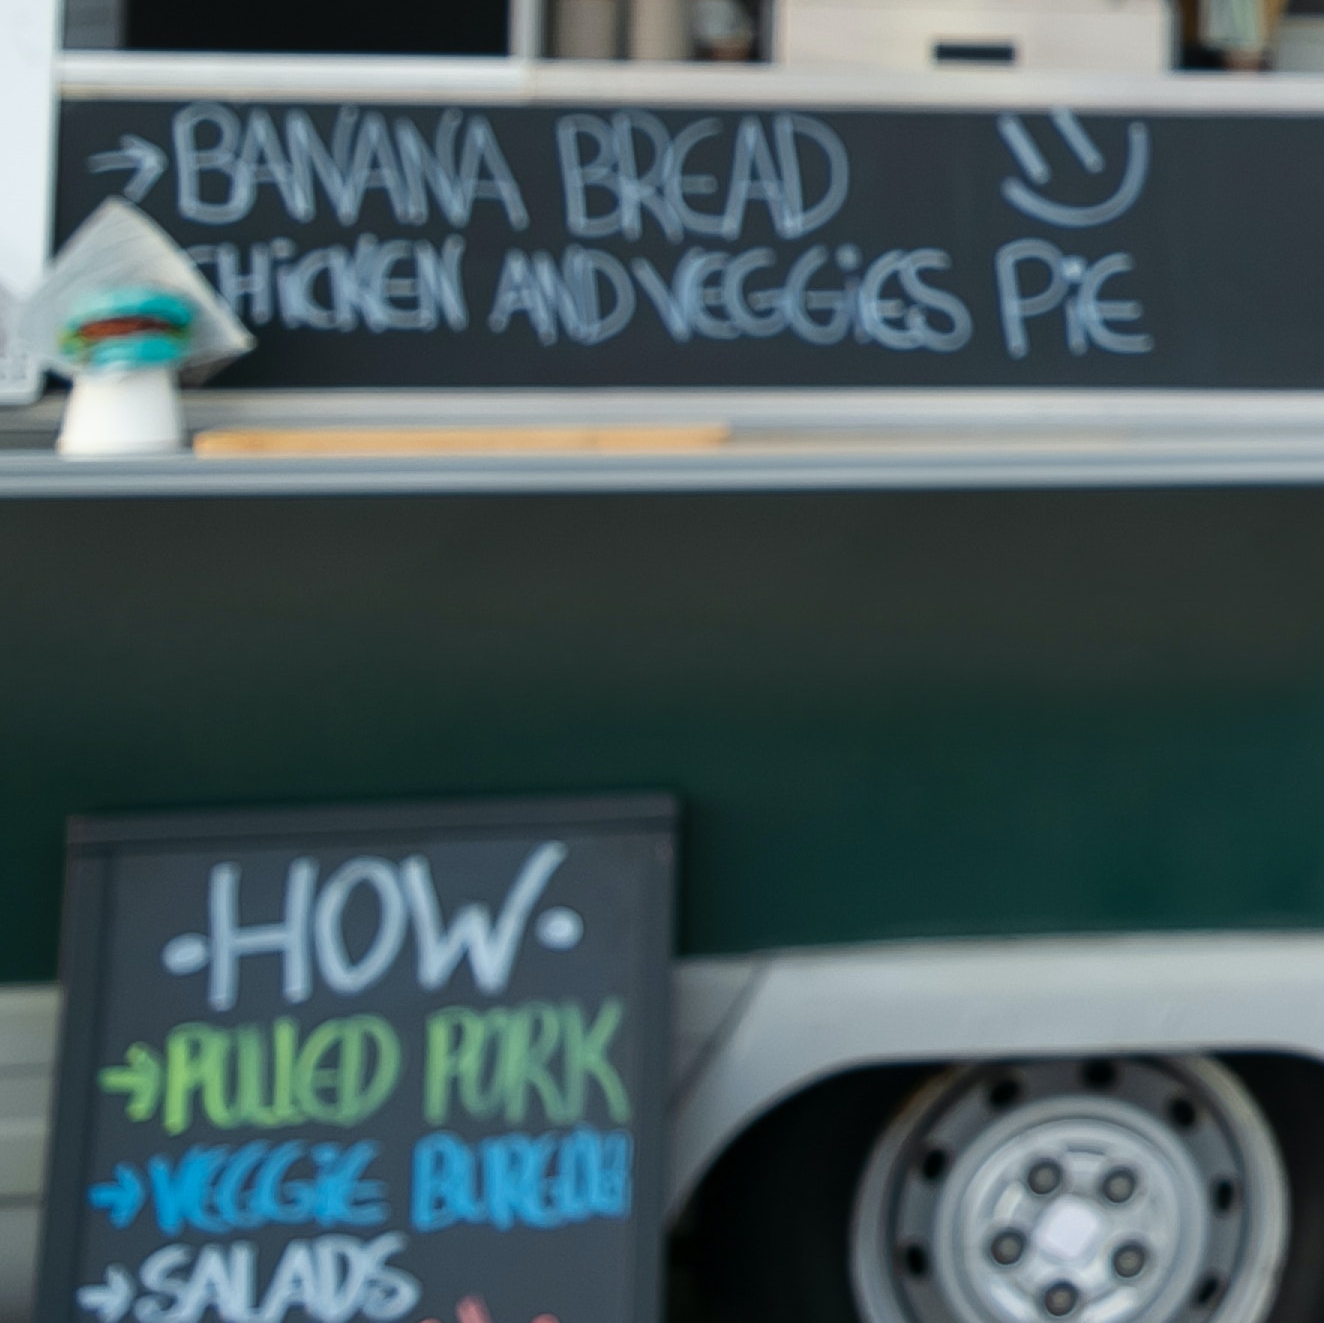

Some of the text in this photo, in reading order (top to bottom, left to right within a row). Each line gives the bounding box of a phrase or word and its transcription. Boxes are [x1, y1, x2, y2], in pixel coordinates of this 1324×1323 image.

[172, 102, 849, 244] BANANA BREAD
[488, 244, 636, 346] AND
[994, 238, 1154, 360] PiE
[207, 840, 569, 1011] HOW
[423, 998, 633, 1127] PORK
[132, 1230, 422, 1323] SALADS
